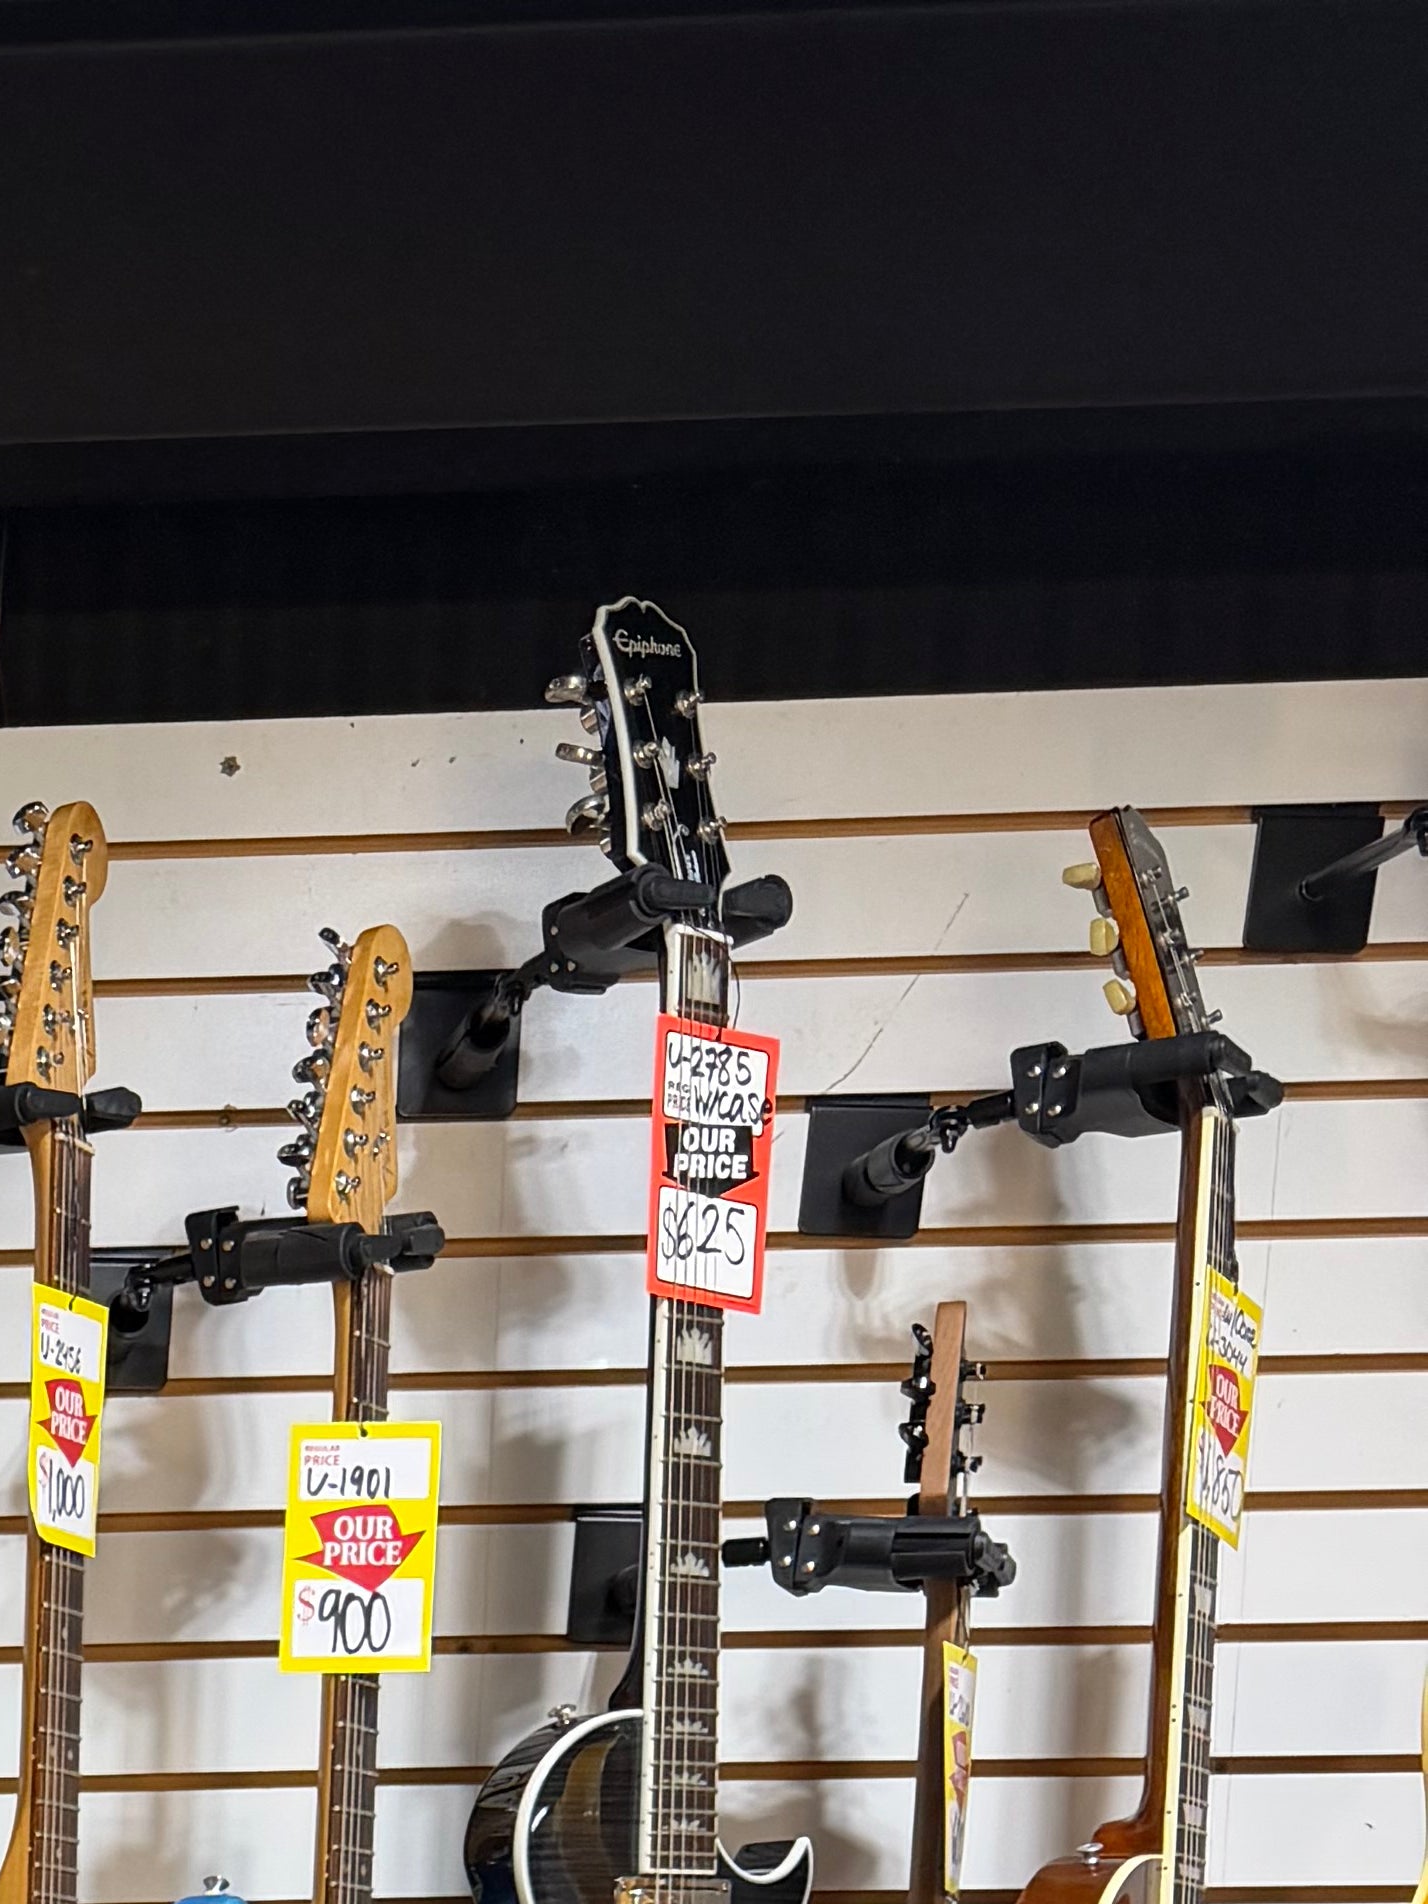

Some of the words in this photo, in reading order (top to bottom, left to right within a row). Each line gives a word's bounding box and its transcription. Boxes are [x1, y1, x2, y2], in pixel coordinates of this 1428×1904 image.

[613, 629, 681, 659] Epiphone
[683, 1127, 736, 1154] OUR
[673, 1153, 749, 1180] PRICE
[661, 1201, 744, 1267] $625
[55, 1386, 83, 1418] OUR
[1215, 1373, 1238, 1408] OUR
[51, 1411, 87, 1446] PRICE
[1211, 1396, 1240, 1436] PRICE
[304, 1454, 341, 1467] PRICE
[39, 1454, 86, 1522] $1,000
[333, 1515, 394, 1541] OUR
[322, 1541, 404, 1567] PRICE
[297, 1585, 392, 1655] $900
